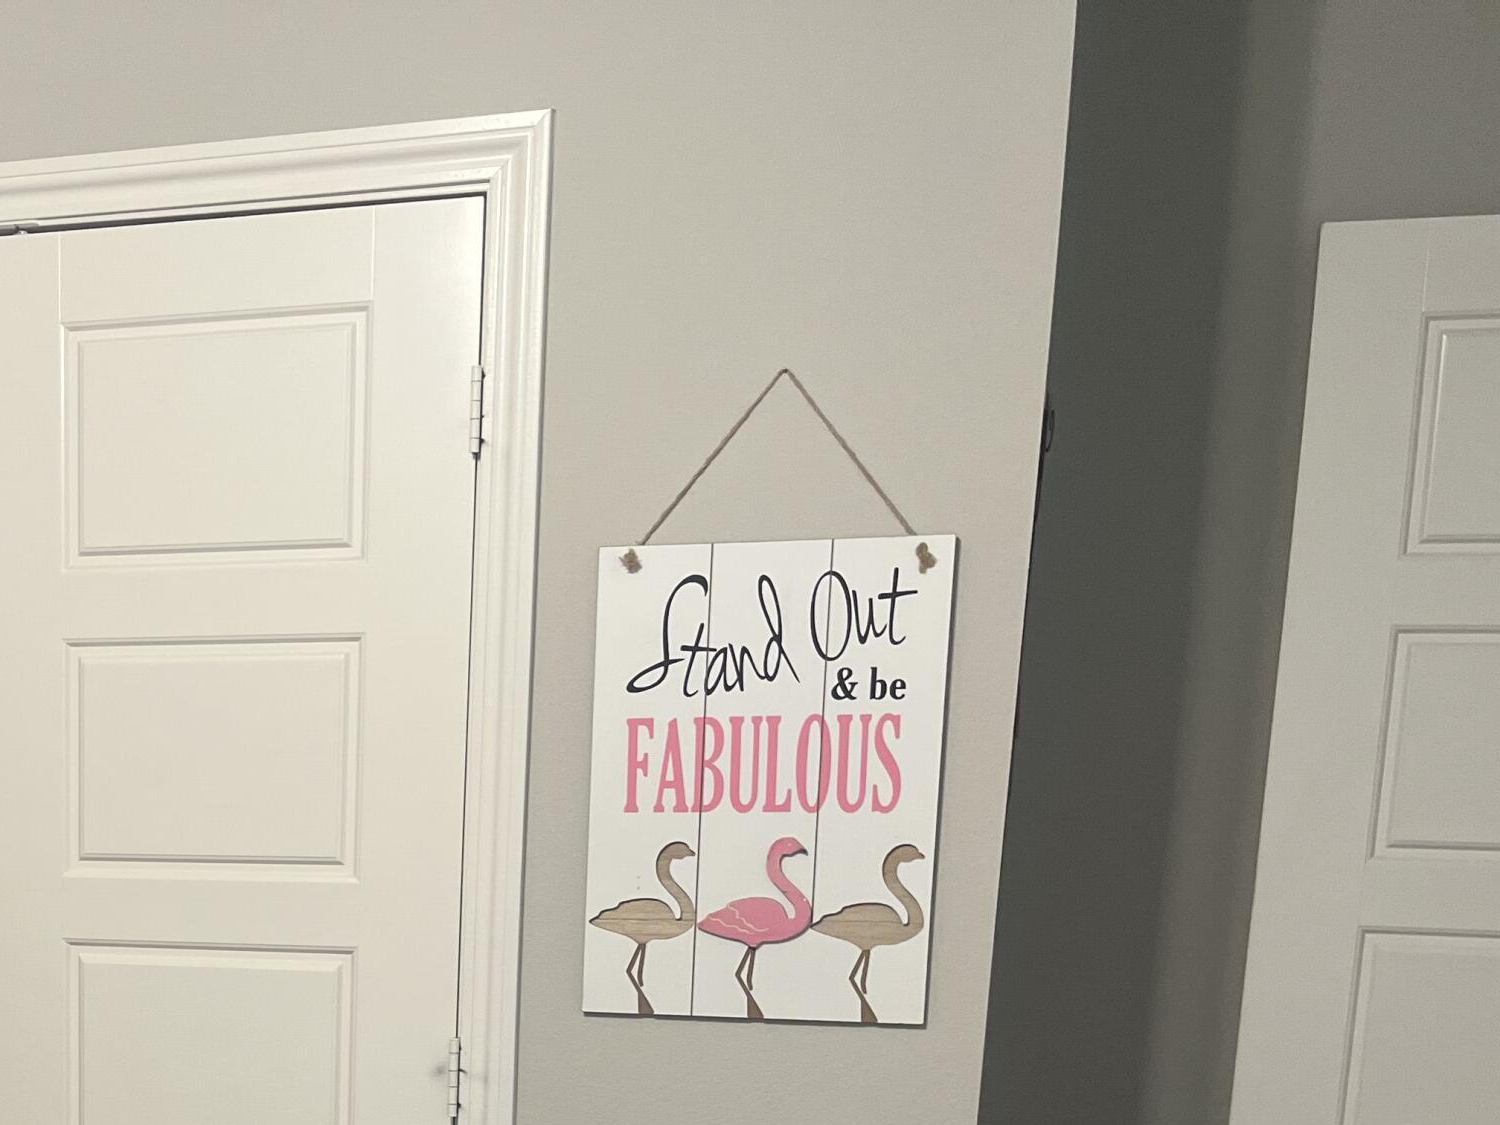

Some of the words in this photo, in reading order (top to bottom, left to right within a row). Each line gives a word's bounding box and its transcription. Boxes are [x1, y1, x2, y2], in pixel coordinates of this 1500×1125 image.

[626, 574, 800, 698] Stand
[810, 566, 918, 662] Out
[830, 667, 858, 701] &
[869, 667, 907, 700] be
[623, 712, 902, 815] FABULOUS
